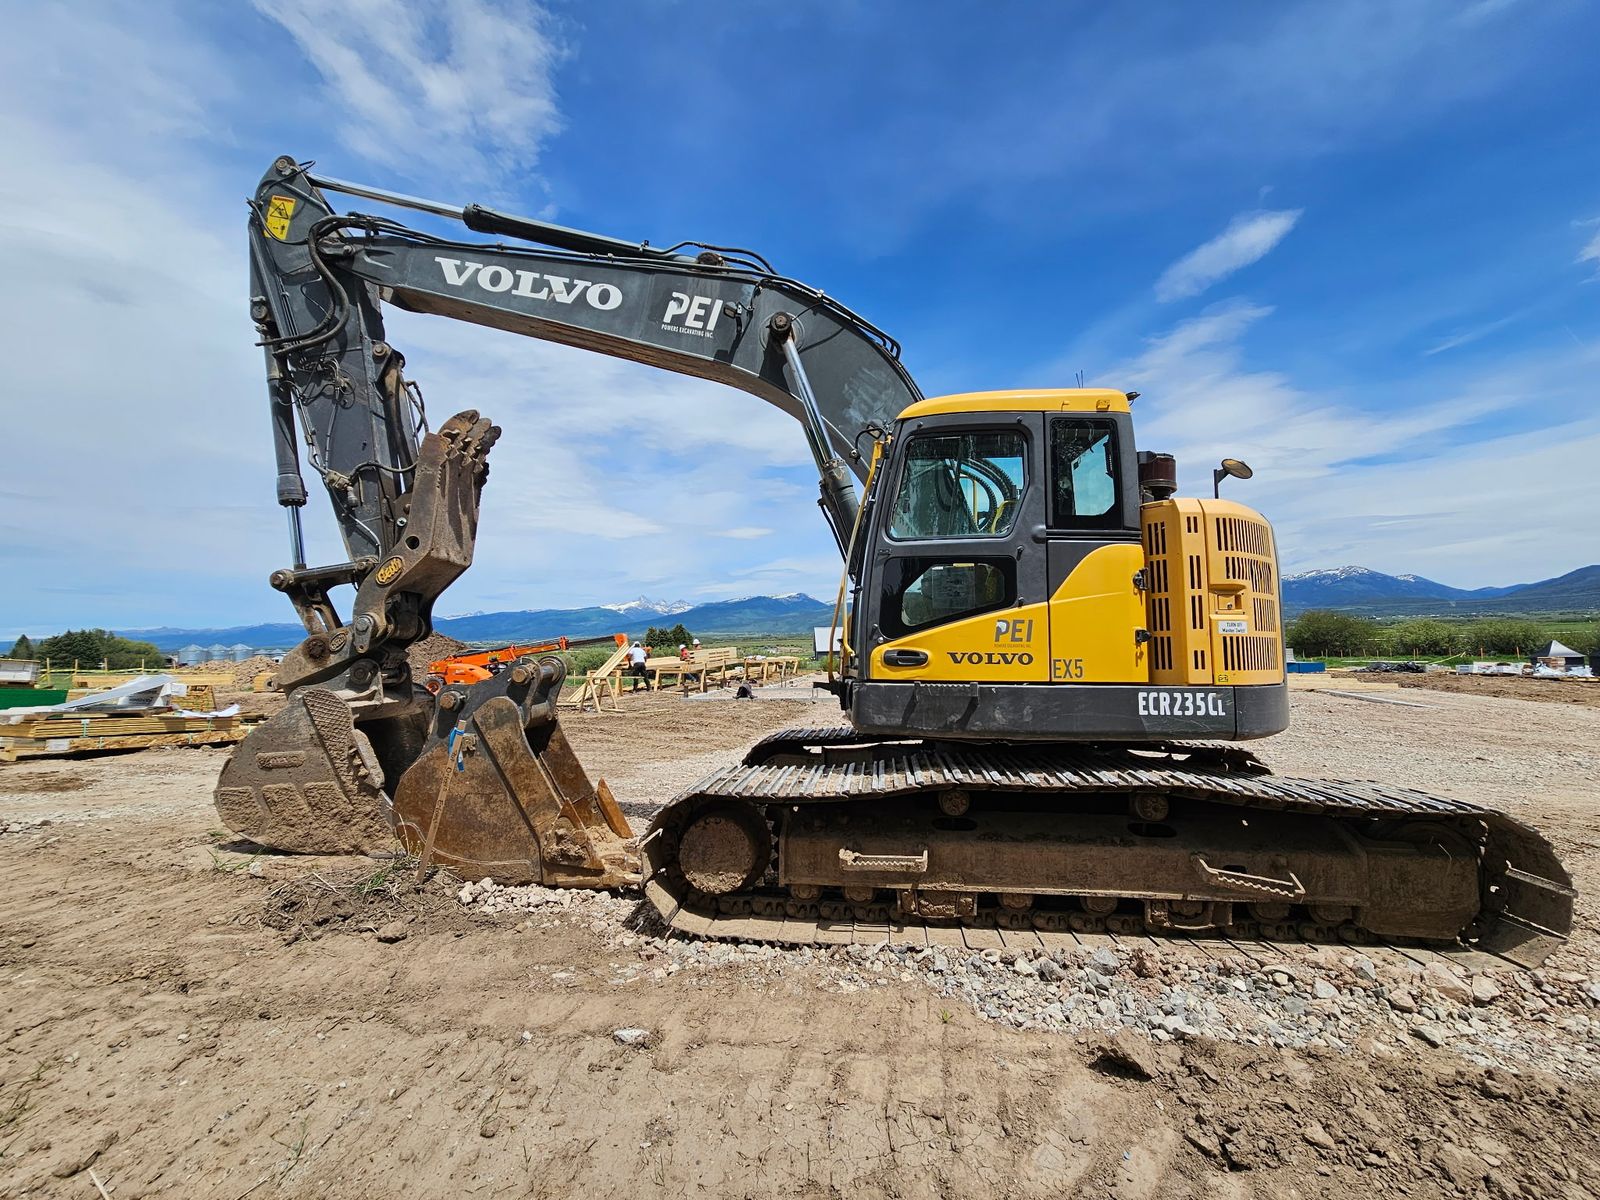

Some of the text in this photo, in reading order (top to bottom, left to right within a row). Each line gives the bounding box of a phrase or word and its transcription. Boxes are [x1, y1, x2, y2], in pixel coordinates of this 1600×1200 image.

[434, 256, 623, 311] VOLVO
[663, 291, 723, 331] PEI
[661, 324, 679, 333] POWERS
[994, 619, 1034, 642] PEI
[947, 652, 1034, 665] VOLVO
[1052, 659, 1083, 679] EX5
[1138, 692, 1226, 716] ECR235CL
